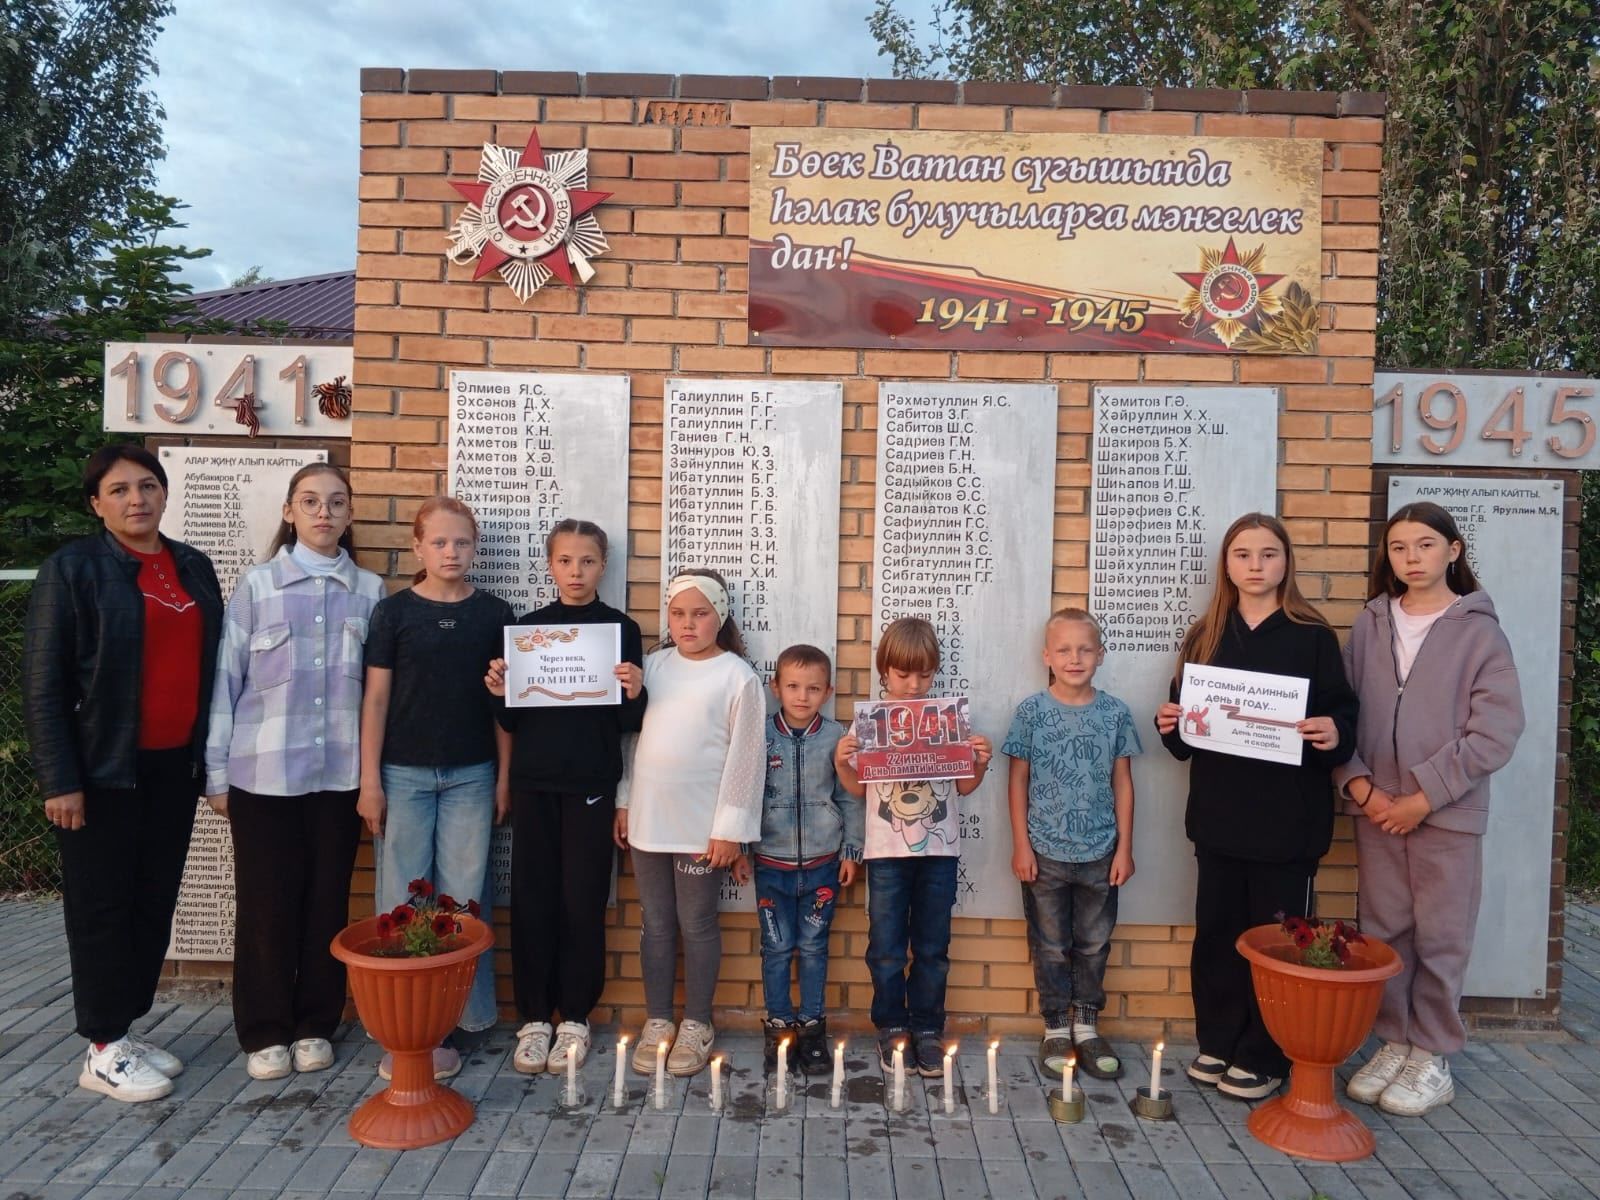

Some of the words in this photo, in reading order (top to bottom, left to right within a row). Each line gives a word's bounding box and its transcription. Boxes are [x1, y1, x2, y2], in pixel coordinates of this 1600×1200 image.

[770, 142, 865, 180] Бөек
[869, 144, 1005, 182] Ватан
[485, 170, 560, 242] ОТЕЧЕСТВЕННАЯ
[770, 187, 880, 226] һәлак
[886, 190, 1128, 240] булучыларга
[1132, 204, 1303, 234] мәнгелек
[770, 233, 855, 271] дан!
[1203, 266, 1253, 313] ОТЕЧЕСТВЕННАЯ
[916, 297, 1009, 331] 1941
[1045, 297, 1150, 334] 1945
[111, 351, 306, 424] 1941
[457, 382, 510, 394] Әлмиев
[519, 384, 546, 395] Я.С.
[457, 395, 516, 408] Әхсәнов
[524, 398, 554, 411] Д.Х.
[671, 390, 743, 404] Галиуллин
[752, 392, 777, 403] Б.Г.
[887, 394, 978, 408] Рәхмәтуллин
[983, 396, 1011, 407] Я.С.
[1100, 395, 1160, 407] Хәмитов
[1165, 396, 1189, 407] Г.Ә.
[457, 409, 516, 421] Әхсәнов
[524, 412, 550, 423] Г.Х.
[671, 404, 743, 417] Галиуллин
[751, 406, 776, 417] Г.Г.
[887, 408, 943, 420] Сабитов
[1100, 409, 1177, 423] Хәйруллин
[1184, 410, 1211, 421] Х.Х.
[671, 417, 742, 431] Галиуллин
[751, 419, 776, 430] Г.Г.
[1375, 382, 1596, 458] 1945
[457, 423, 517, 435] Ахметов
[526, 425, 552, 437] К.Н.
[886, 421, 943, 433] Сабитов
[948, 422, 978, 434] Ш.С.
[1100, 423, 1191, 436] Хөснетдинов
[1198, 423, 1228, 435] Х.Ш.
[457, 437, 517, 449] Ахметов
[526, 439, 555, 450] Г.Ш.
[671, 431, 718, 442] Ганиев
[725, 432, 752, 443] Г.Н.
[886, 435, 945, 448] Садриев
[950, 436, 974, 447] Г.М.
[1098, 437, 1159, 450] Шакиров
[1164, 438, 1192, 448] Б.Х.
[457, 450, 517, 462] Ахметов
[526, 452, 555, 464] Х.Ә.
[671, 444, 735, 458] Зиннуров
[742, 446, 774, 458] Ю.З.
[886, 448, 944, 462] Садриев
[950, 450, 975, 461] Г.Н.
[1098, 450, 1159, 464] Шакиров
[1164, 451, 1188, 462] Х.Г.
[239, 458, 264, 466] АЛЫП
[671, 458, 743, 472] Зәйнуллин
[752, 460, 778, 471] К.З.
[885, 462, 944, 475] Садриев
[949, 464, 976, 474] Б.Н.
[456, 464, 517, 476] Ахметов
[525, 466, 556, 477] Ә.Ш.
[1098, 464, 1160, 476] Шиһапов
[1165, 465, 1191, 476] Г.Ш.
[185, 473, 234, 483] Абубакиров
[236, 474, 252, 483] Г.Д.
[456, 477, 528, 490] Ахметшин
[536, 480, 563, 491] Г.А.
[670, 472, 744, 484] Ибатуллин
[752, 473, 777, 485] Б.Г.
[885, 475, 952, 489] Садыйков
[957, 477, 984, 488] С.С.
[1097, 478, 1159, 489] Шиһапов
[1164, 478, 1195, 490] И.Ш.
[455, 491, 530, 504] Бахтияров
[539, 493, 563, 504] З.Г.
[670, 485, 743, 498] Ибатуллин
[752, 487, 778, 498] Б.З.
[885, 489, 952, 502] Садыйков
[957, 490, 984, 502] Ә.С.
[1096, 491, 1158, 503] Шиһапов
[1164, 492, 1188, 503] Ә.Г.
[1416, 487, 1441, 496] АЛАР
[1443, 488, 1469, 498] ҖИҢҮ
[1471, 488, 1499, 497] АЛЫП
[1501, 487, 1540, 498] КАЙТТЫ.
[224, 502, 243, 510] Х.Ш.
[670, 498, 743, 511] Ибатуллин
[751, 501, 777, 511] Г.Б.
[884, 503, 958, 514] Салаватов
[1492, 505, 1535, 516] Яруллин
[1538, 507, 1559, 516] М.Я.
[1096, 505, 1171, 518] Шәрәфиев
[1177, 506, 1205, 517] С.К.
[669, 512, 743, 525] Ибатуллин
[751, 514, 777, 525] Г.Б.
[884, 516, 961, 530] Сафиуллин
[966, 517, 988, 529] Г.С.
[1096, 519, 1171, 533] Шәрәфиев
[1176, 520, 1205, 531] М.К.
[229, 530, 245, 538] С.Г.
[883, 529, 961, 543] Сафиуллин
[965, 531, 992, 542] К.С.
[540, 655, 563, 663] Через
[1189, 676, 1205, 686] Тот
[1207, 679, 1245, 692] самый
[1248, 686, 1298, 700] длинный
[1205, 694, 1232, 706] день
[1243, 699, 1276, 711] году...
[868, 703, 960, 748] 1941
[1232, 728, 1251, 736] День
[1253, 732, 1280, 740] памяти
[1251, 740, 1280, 749] скорби
[887, 753, 901, 766] 22
[864, 766, 889, 779] День
[890, 764, 926, 775] памяти
[928, 763, 934, 773] и
[935, 760, 970, 772] скорби
